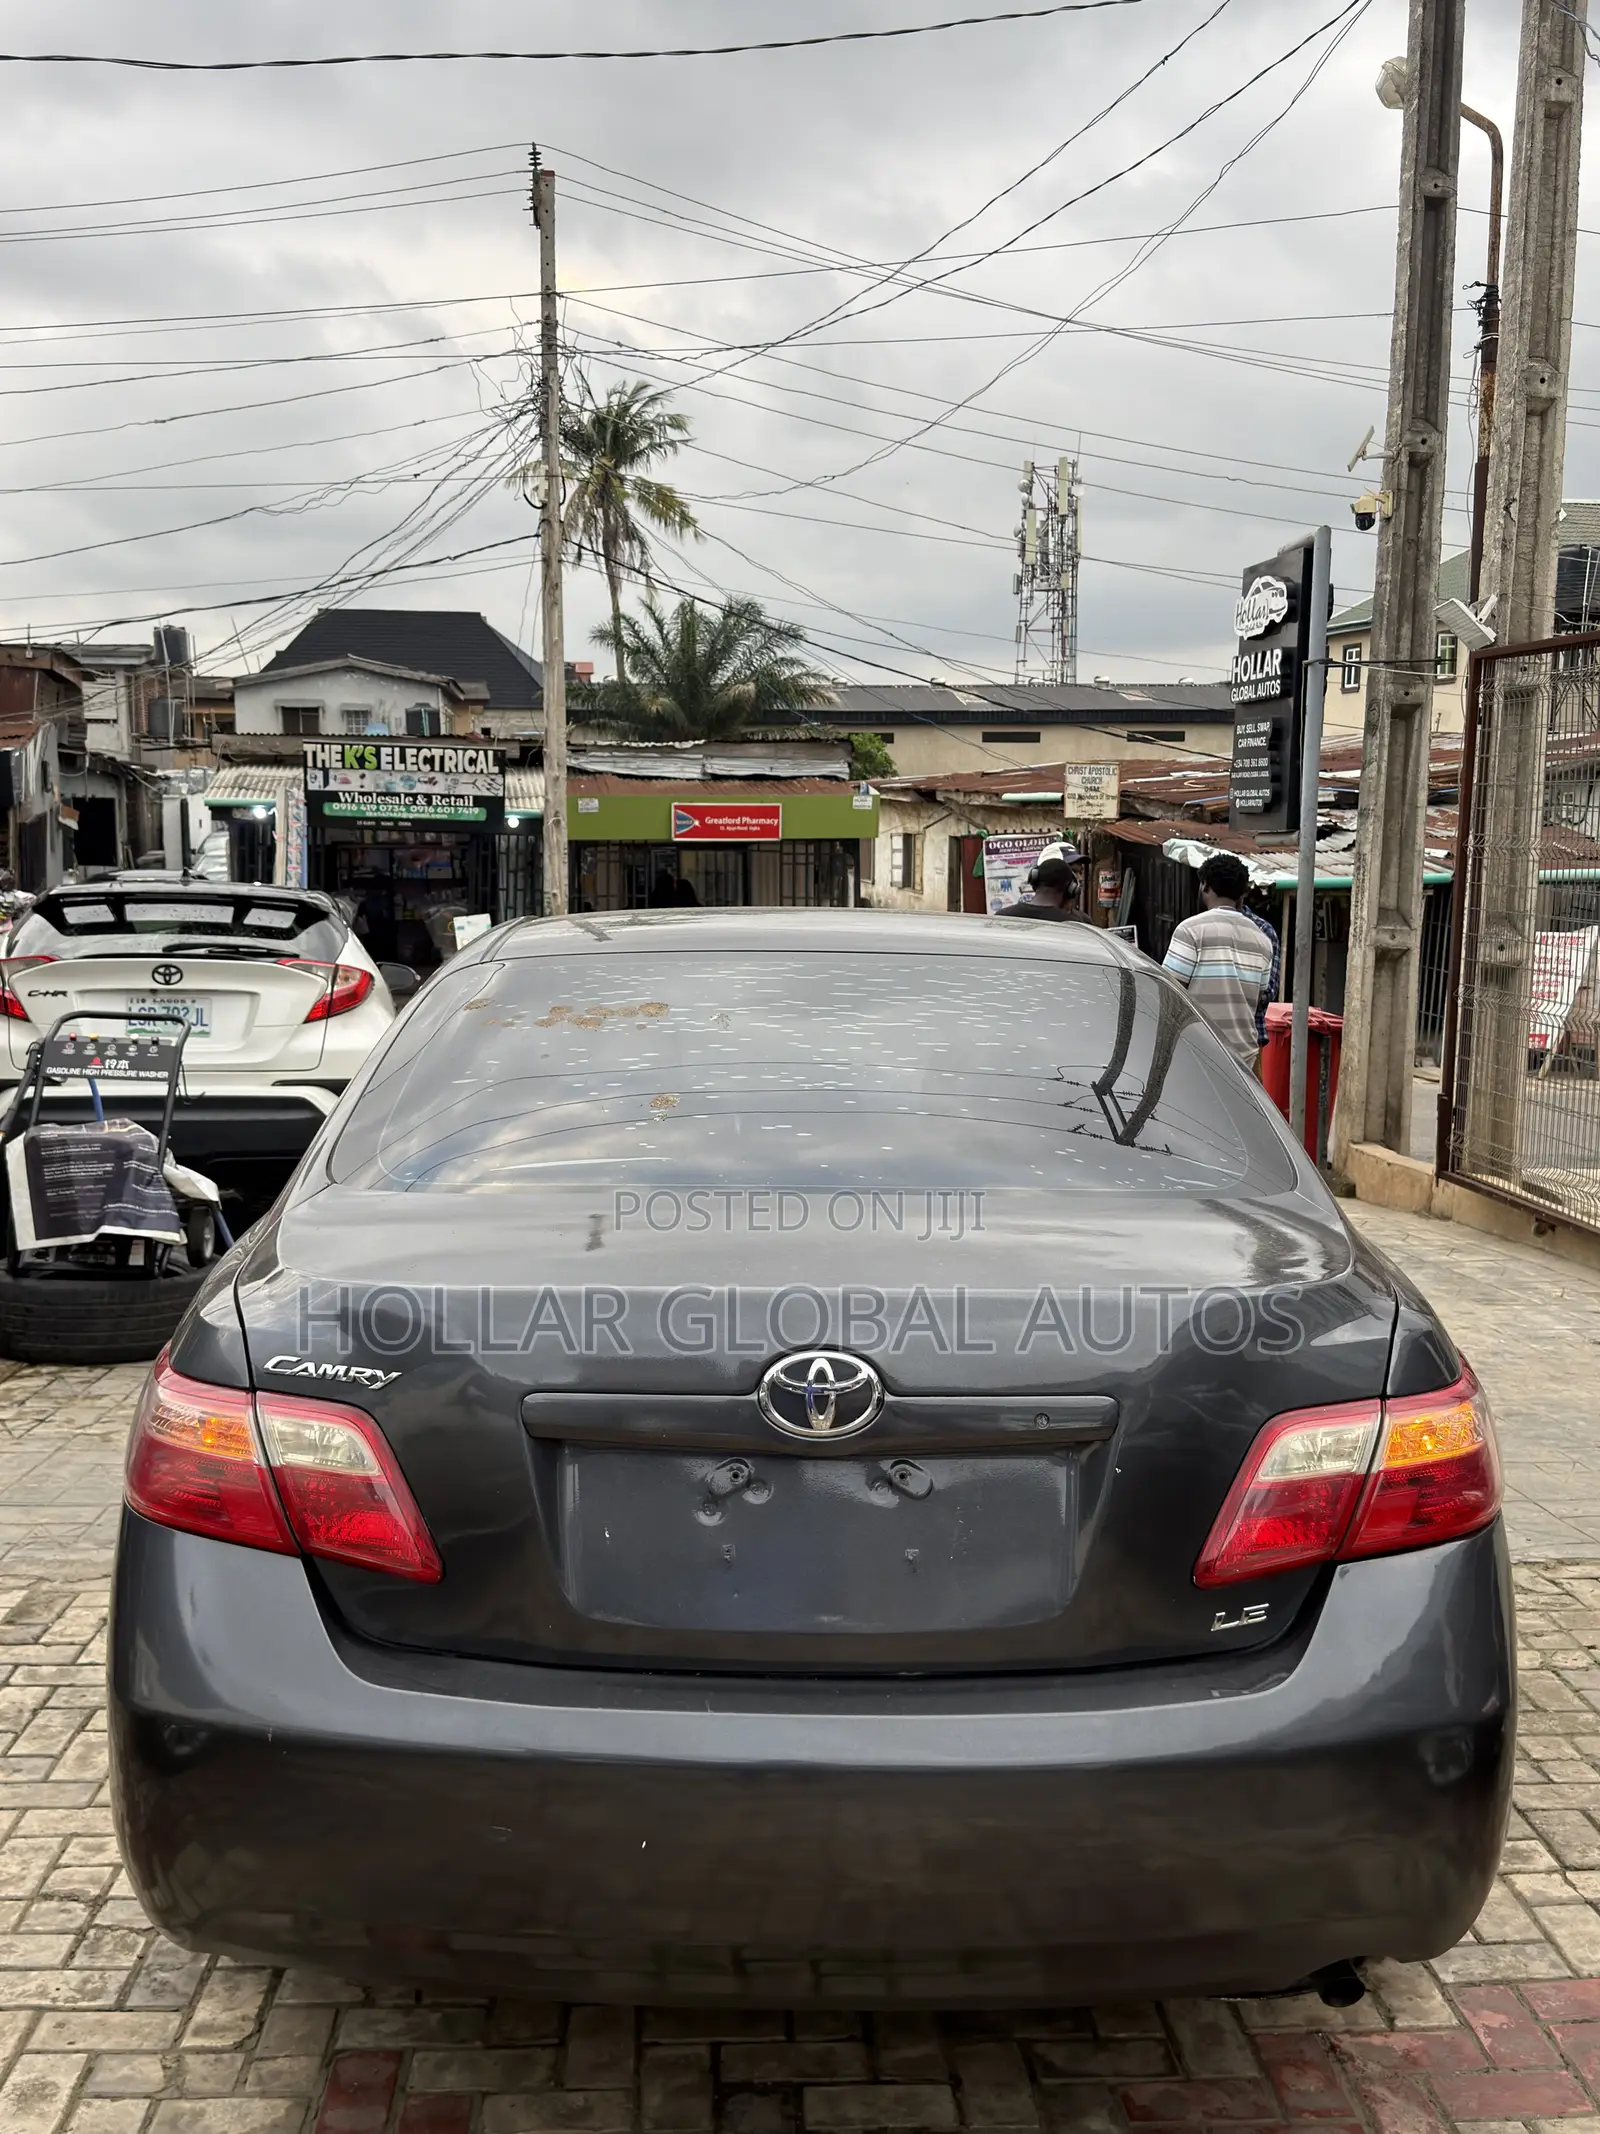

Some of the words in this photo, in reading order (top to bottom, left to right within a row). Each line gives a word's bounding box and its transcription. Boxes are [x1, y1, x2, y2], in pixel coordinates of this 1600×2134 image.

[1232, 649, 1281, 684] HOLLAR
[1231, 683, 1256, 702] GLOBAL
[1257, 680, 1281, 697] AUTOS
[1237, 738, 1247, 748] CAR
[303, 743, 343, 769] THE
[343, 744, 377, 770] K'S
[380, 746, 499, 774] ELECTRICAL
[1068, 766, 1087, 775] CHRIST
[1088, 766, 1117, 776] APOSTOLIC
[1081, 776, 1103, 785] CHURCH
[338, 791, 413, 806] Wholesale
[416, 794, 428, 806] &
[432, 795, 474, 807] Retail
[332, 802, 358, 812] 0916
[360, 803, 377, 812] 419
[379, 803, 406, 813] 0734
[410, 805, 435, 814] 0916
[437, 806, 456, 815] 601
[456, 806, 479, 815] 7419
[742, 817, 779, 827] Pharmacy
[988, 840, 1013, 850] OGO
[46, 1066, 81, 1075] GASOLINE
[82, 1068, 100, 1076] HIGH
[100, 1069, 138, 1077] PRESSURE
[138, 1070, 169, 1078] WASHER
[263, 1354, 402, 1391] CAMRY
[1210, 1602, 1270, 1632] LE
